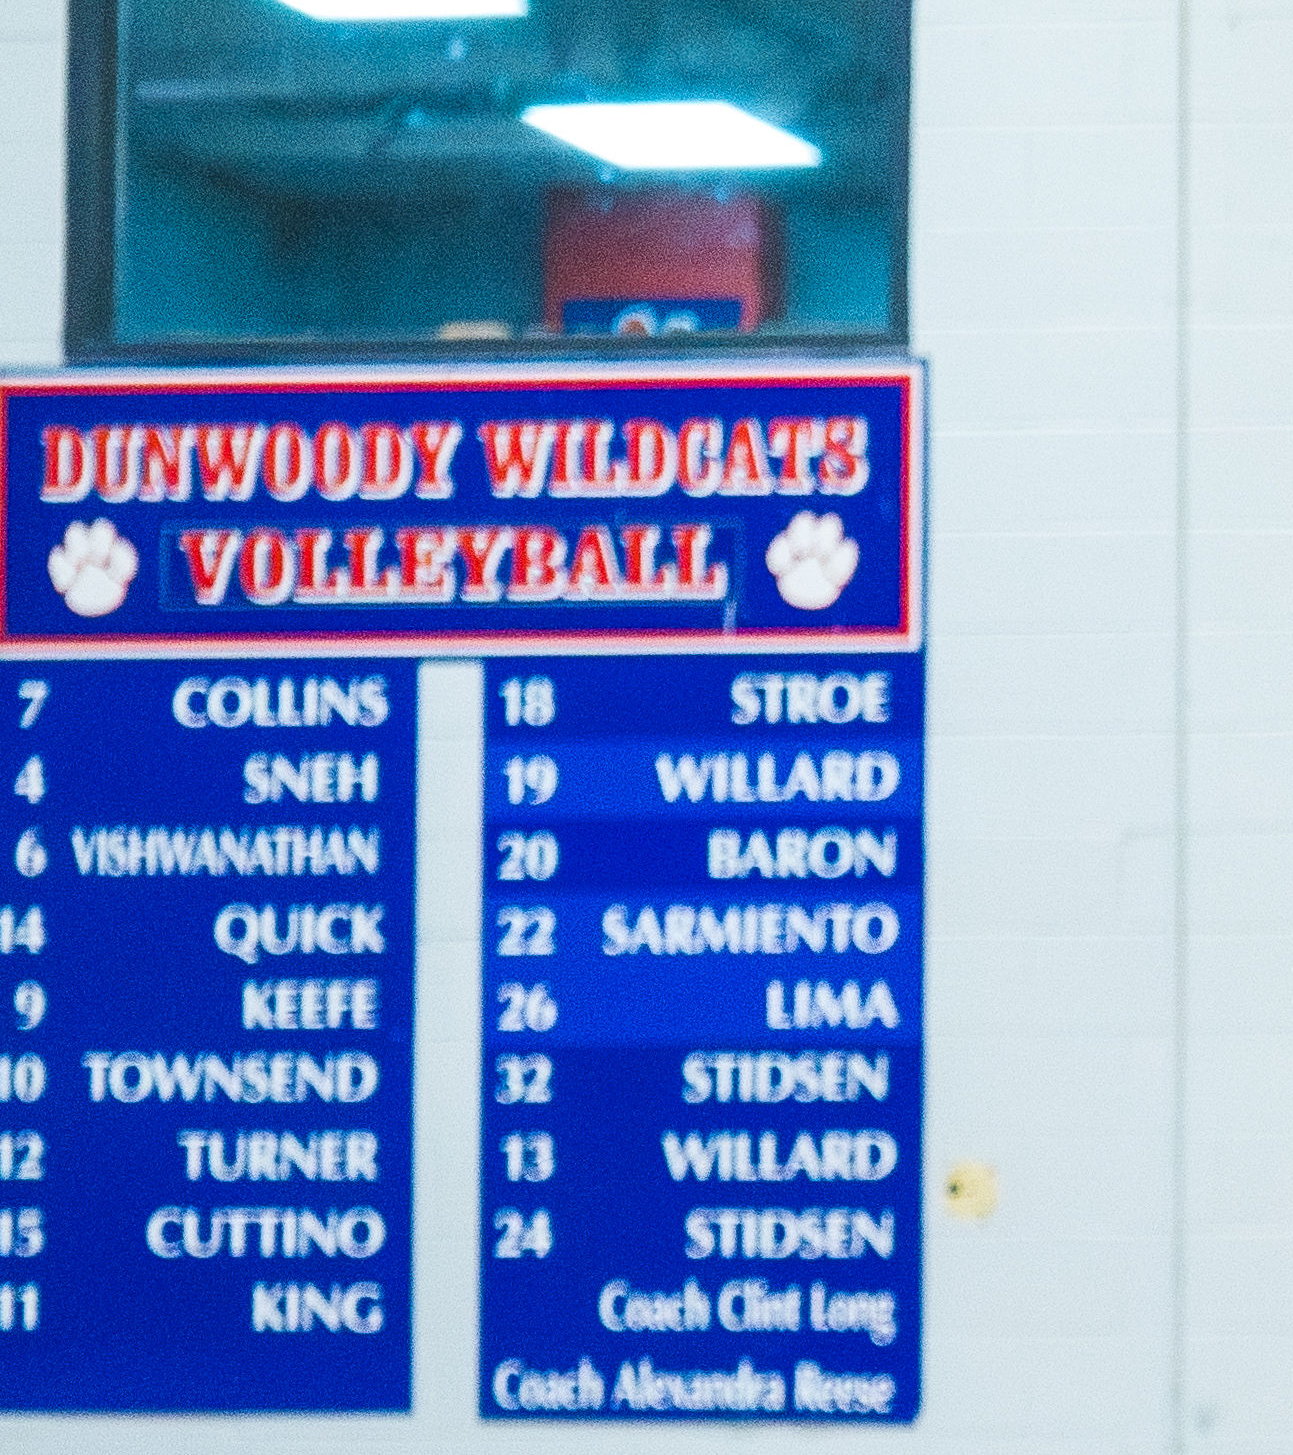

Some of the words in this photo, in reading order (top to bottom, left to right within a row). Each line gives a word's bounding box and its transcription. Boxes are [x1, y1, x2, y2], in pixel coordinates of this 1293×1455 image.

[41, 421, 462, 503] DUNWOODY
[478, 416, 869, 498] WILDCATS
[180, 522, 729, 605] VOLLEYBALL
[19, 680, 49, 728] 7
[171, 678, 390, 729] COLLINS
[502, 679, 556, 727] 18
[730, 672, 888, 726] STROE
[14, 756, 46, 805] 4
[243, 752, 379, 805] SNEH
[504, 756, 559, 805] 19
[654, 750, 901, 804] WILLARD
[14, 830, 48, 877] 6
[71, 826, 380, 877] VISHWANATHAN
[498, 833, 559, 881] 20
[707, 829, 897, 880] BARON
[213, 905, 385, 965] QUICK
[497, 907, 557, 957] 22
[601, 902, 901, 957] SARMIENTO
[13, 984, 47, 1029] 9
[242, 979, 376, 1031] KEEFE
[498, 982, 559, 1033] 26
[765, 979, 900, 1031] LIMA
[84, 1052, 380, 1104] TOWNSEND
[496, 1054, 553, 1104] 32
[682, 1051, 889, 1104] STIDSEN
[180, 1131, 379, 1182] TURNER
[504, 1133, 555, 1182] 13
[662, 1130, 899, 1182] WILLARD
[145, 1207, 387, 1259] CUTTINO
[496, 1210, 553, 1259] 24
[685, 1208, 895, 1260] STIDSEN
[253, 1285, 382, 1332] KING
[599, 1277, 711, 1332] Coach
[810, 1280, 897, 1346] Long
[493, 1356, 604, 1411] Coach
